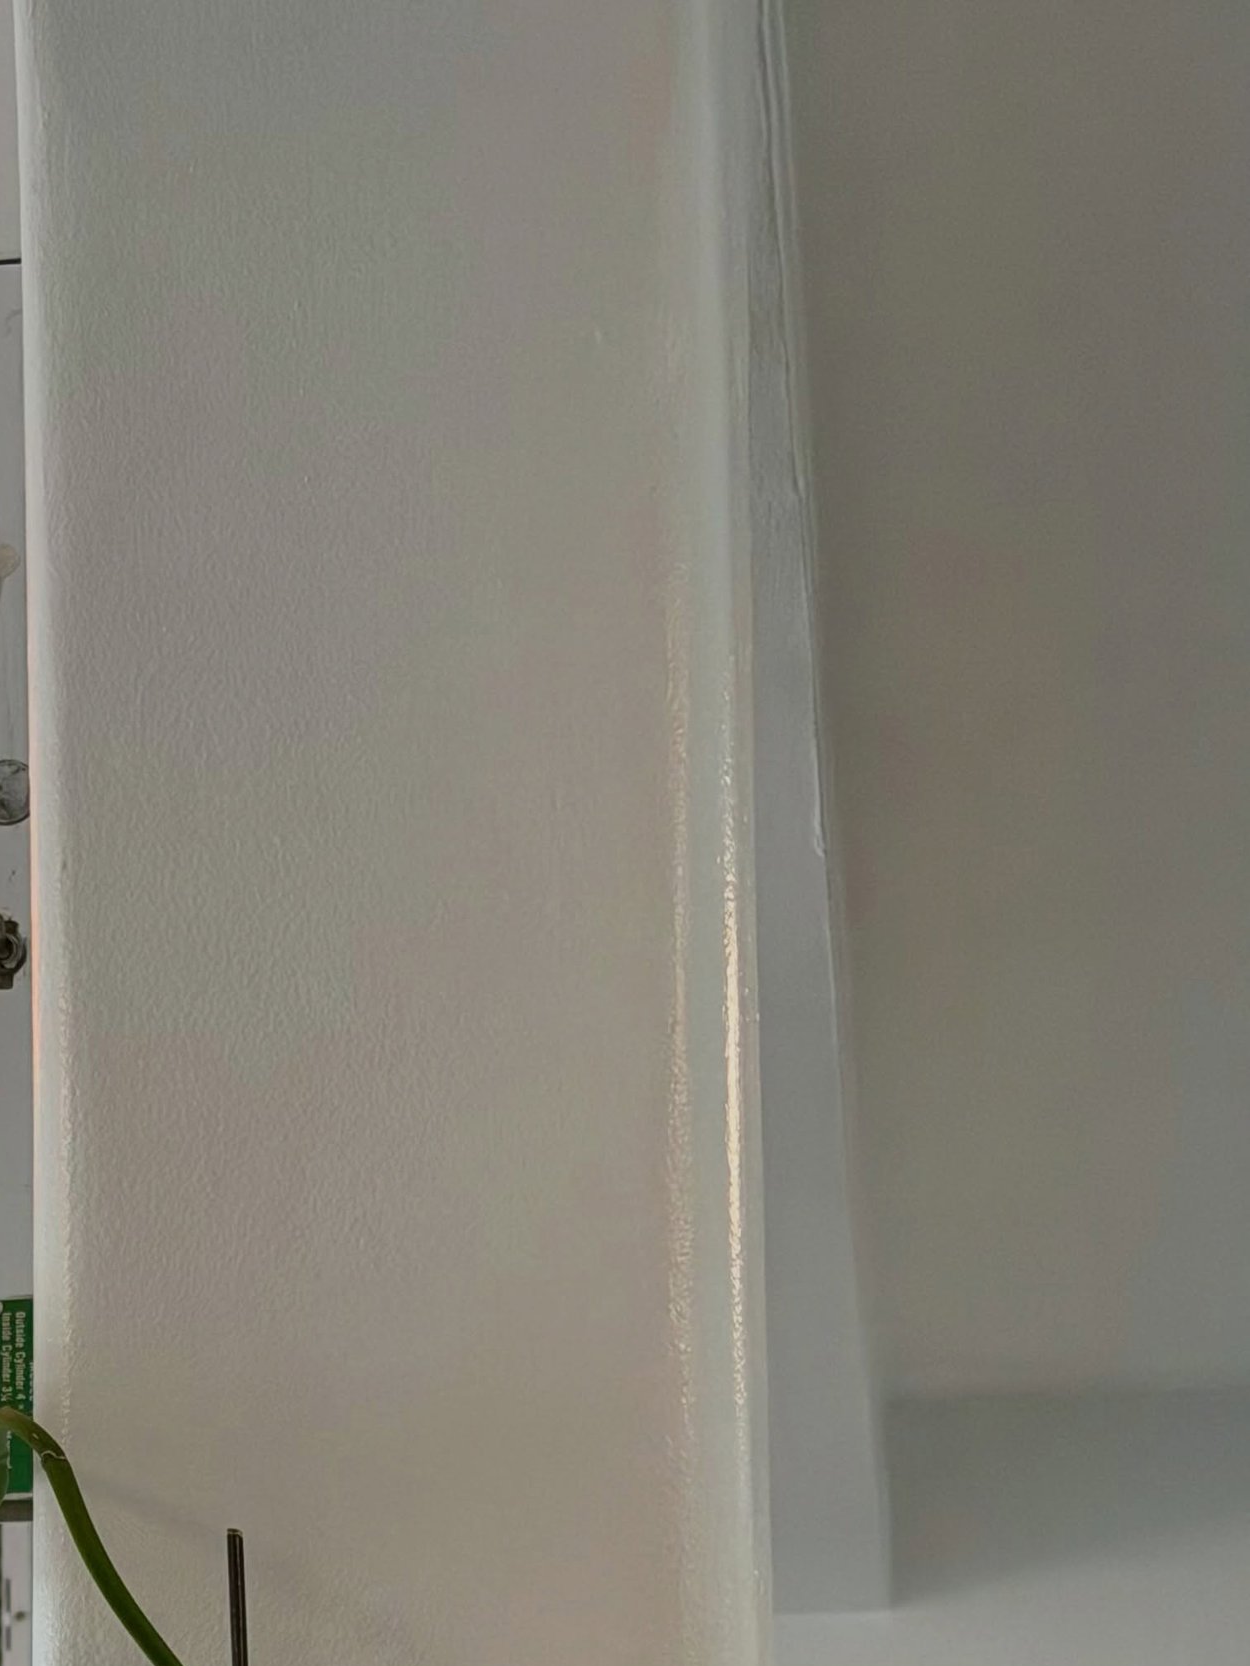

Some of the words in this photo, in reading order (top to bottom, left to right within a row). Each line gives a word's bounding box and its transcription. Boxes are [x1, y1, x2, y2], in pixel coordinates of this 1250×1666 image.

[2, 1312, 12, 1341] Inside
[15, 1311, 26, 1348] Outside
[0, 1344, 12, 1382] Cylinder
[14, 1351, 26, 1390] Cylinder
